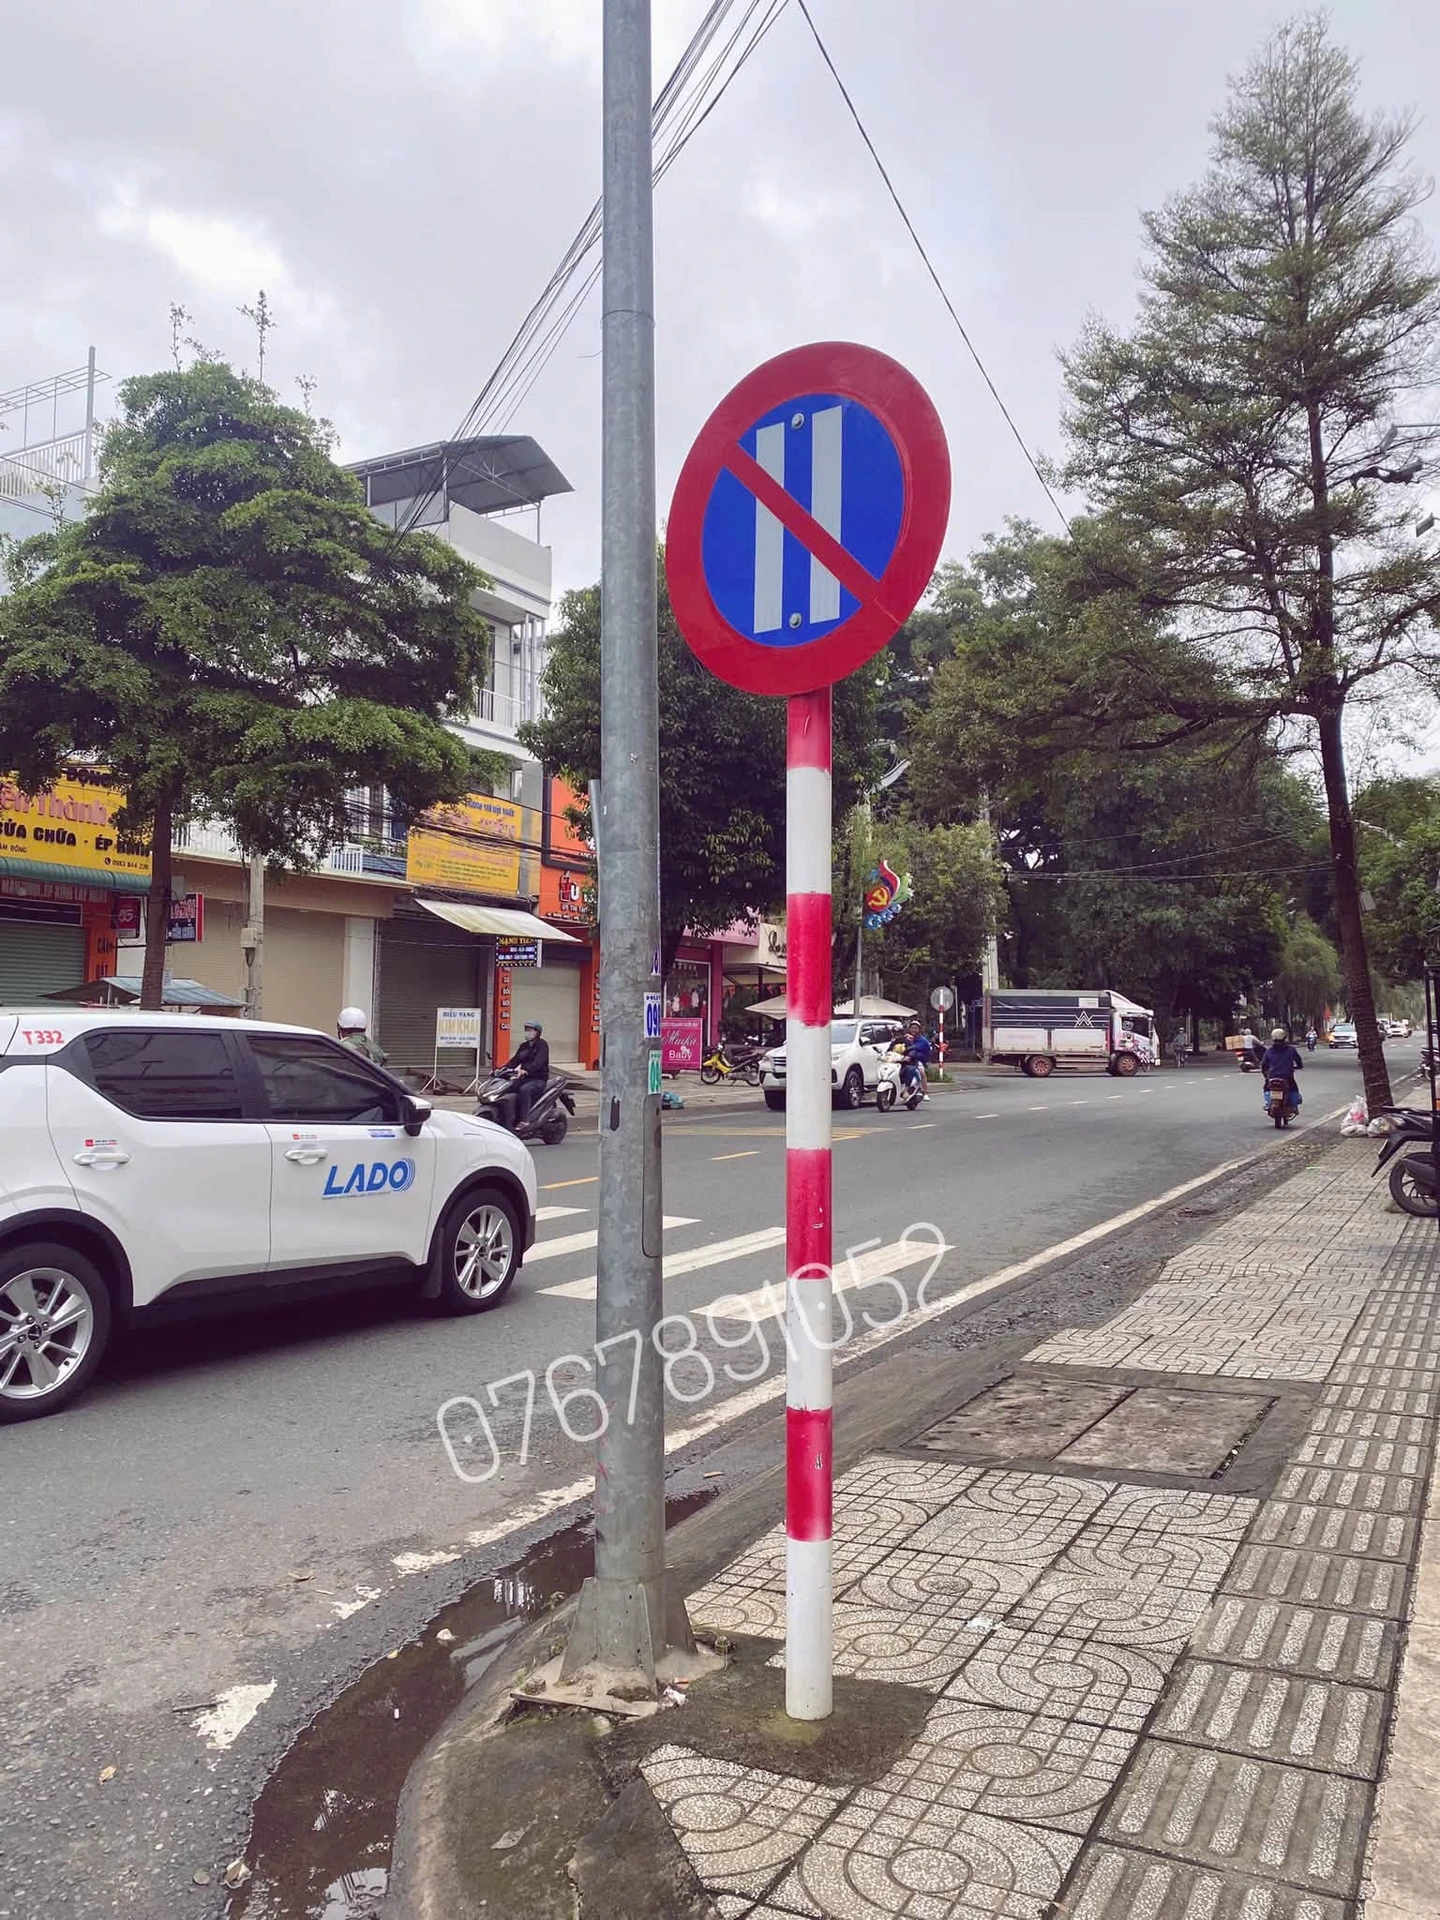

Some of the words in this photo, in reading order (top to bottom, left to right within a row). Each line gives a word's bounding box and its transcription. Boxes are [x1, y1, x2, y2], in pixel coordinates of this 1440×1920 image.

[33, 827, 77, 847] CHỮA
[668, 1050, 692, 1061] Baby
[323, 1158, 410, 1196] LADO
